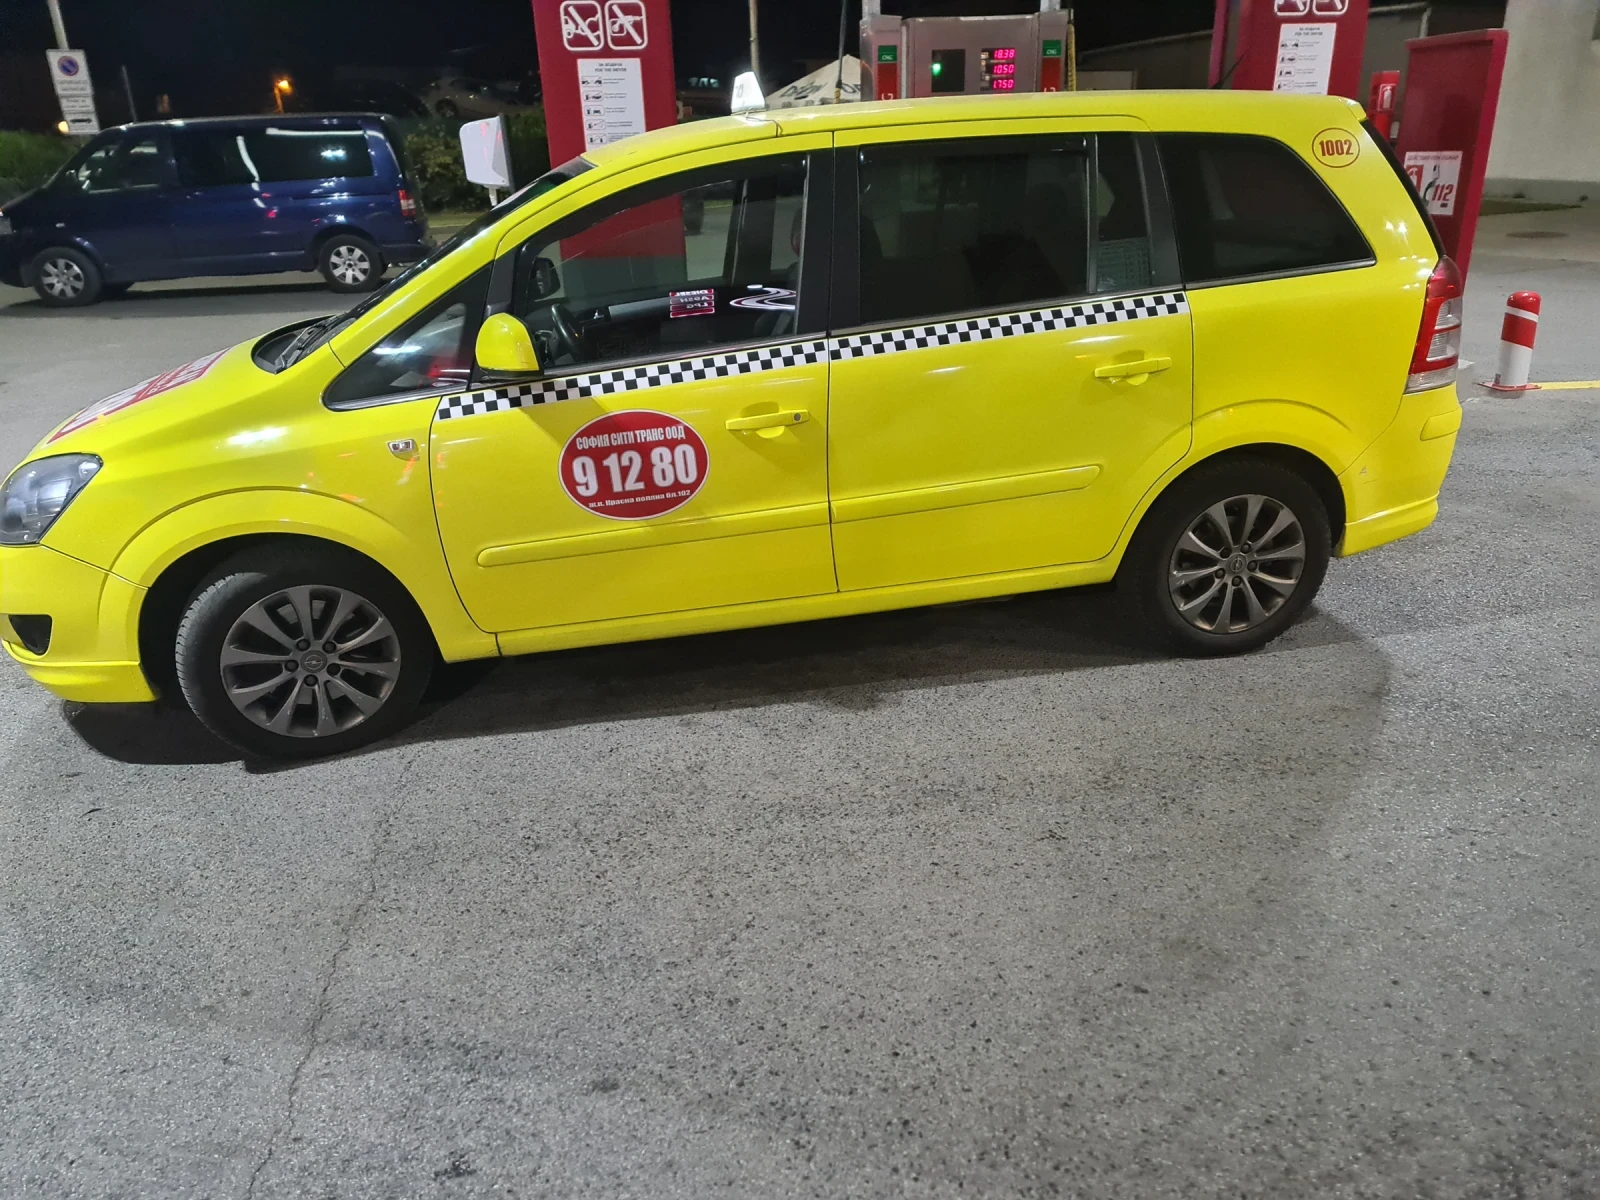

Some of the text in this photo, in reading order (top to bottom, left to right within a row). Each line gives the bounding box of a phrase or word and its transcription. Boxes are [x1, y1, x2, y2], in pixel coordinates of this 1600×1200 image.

[1319, 139, 1354, 156] 1002
[1432, 183, 1454, 202] 112
[576, 425, 685, 450] СОФИЯ СИТИ ТРАНС ООД
[572, 444, 698, 498] 9 12 80
[605, 498, 635, 507] Красна
